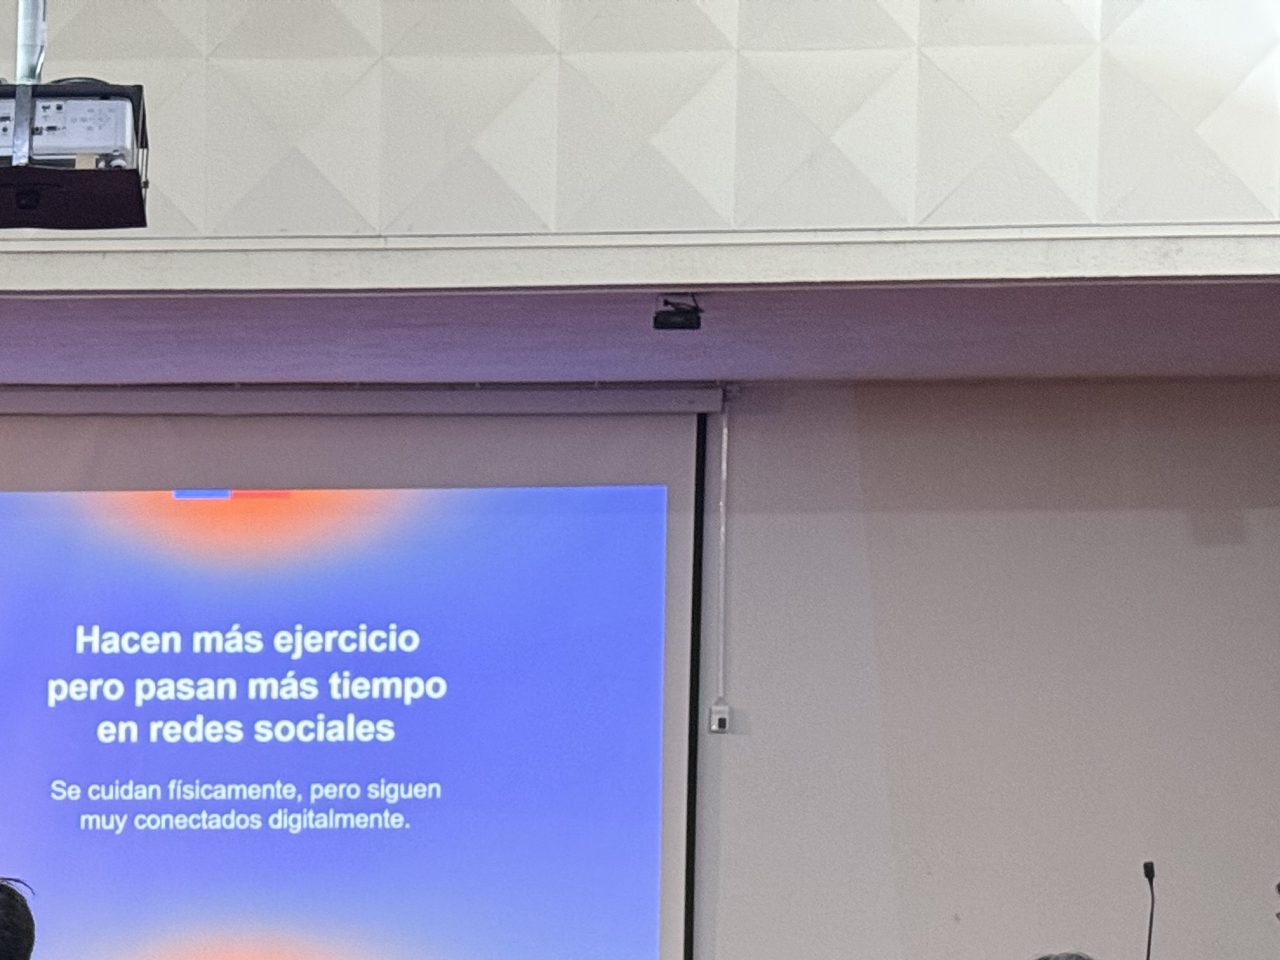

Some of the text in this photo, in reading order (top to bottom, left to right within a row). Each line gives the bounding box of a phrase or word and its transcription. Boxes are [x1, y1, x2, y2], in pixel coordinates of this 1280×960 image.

[75, 623, 421, 660] Hacen más ejercicio
[47, 670, 448, 708] pero pasan más tiempo
[97, 713, 395, 743] en redes sociales
[50, 778, 442, 805] Se cuidan físicamente, pero siguen
[80, 808, 411, 835] muy conectados digitalmente.
